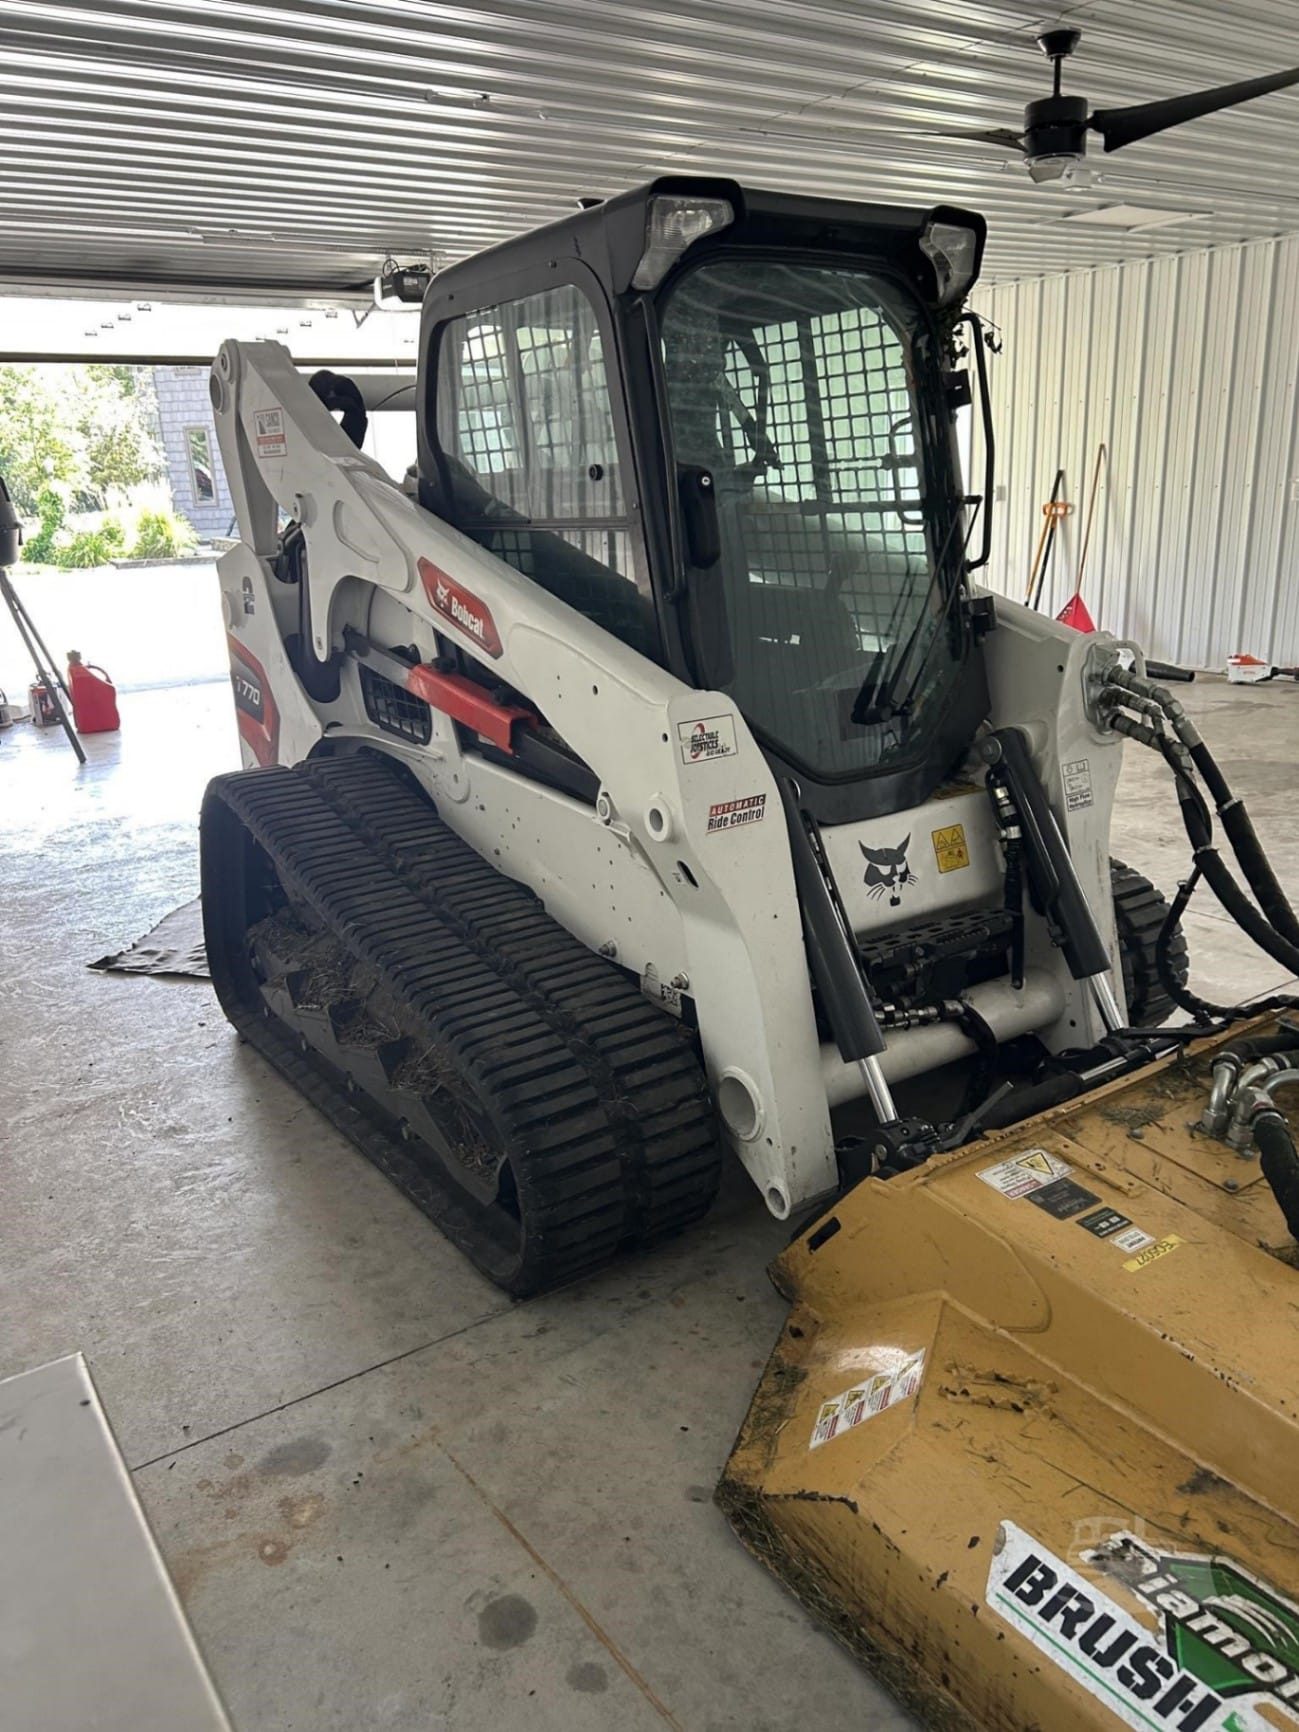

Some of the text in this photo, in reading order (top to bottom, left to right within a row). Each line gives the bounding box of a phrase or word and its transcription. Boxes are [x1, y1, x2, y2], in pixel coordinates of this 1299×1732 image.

[451, 596, 485, 639] Bobcat
[707, 806, 765, 830] Ride Control
[711, 796, 765, 816] AUTOMATIC
[1107, 1540, 1299, 1698] iamo
[1003, 1553, 1222, 1732] BRUSH
